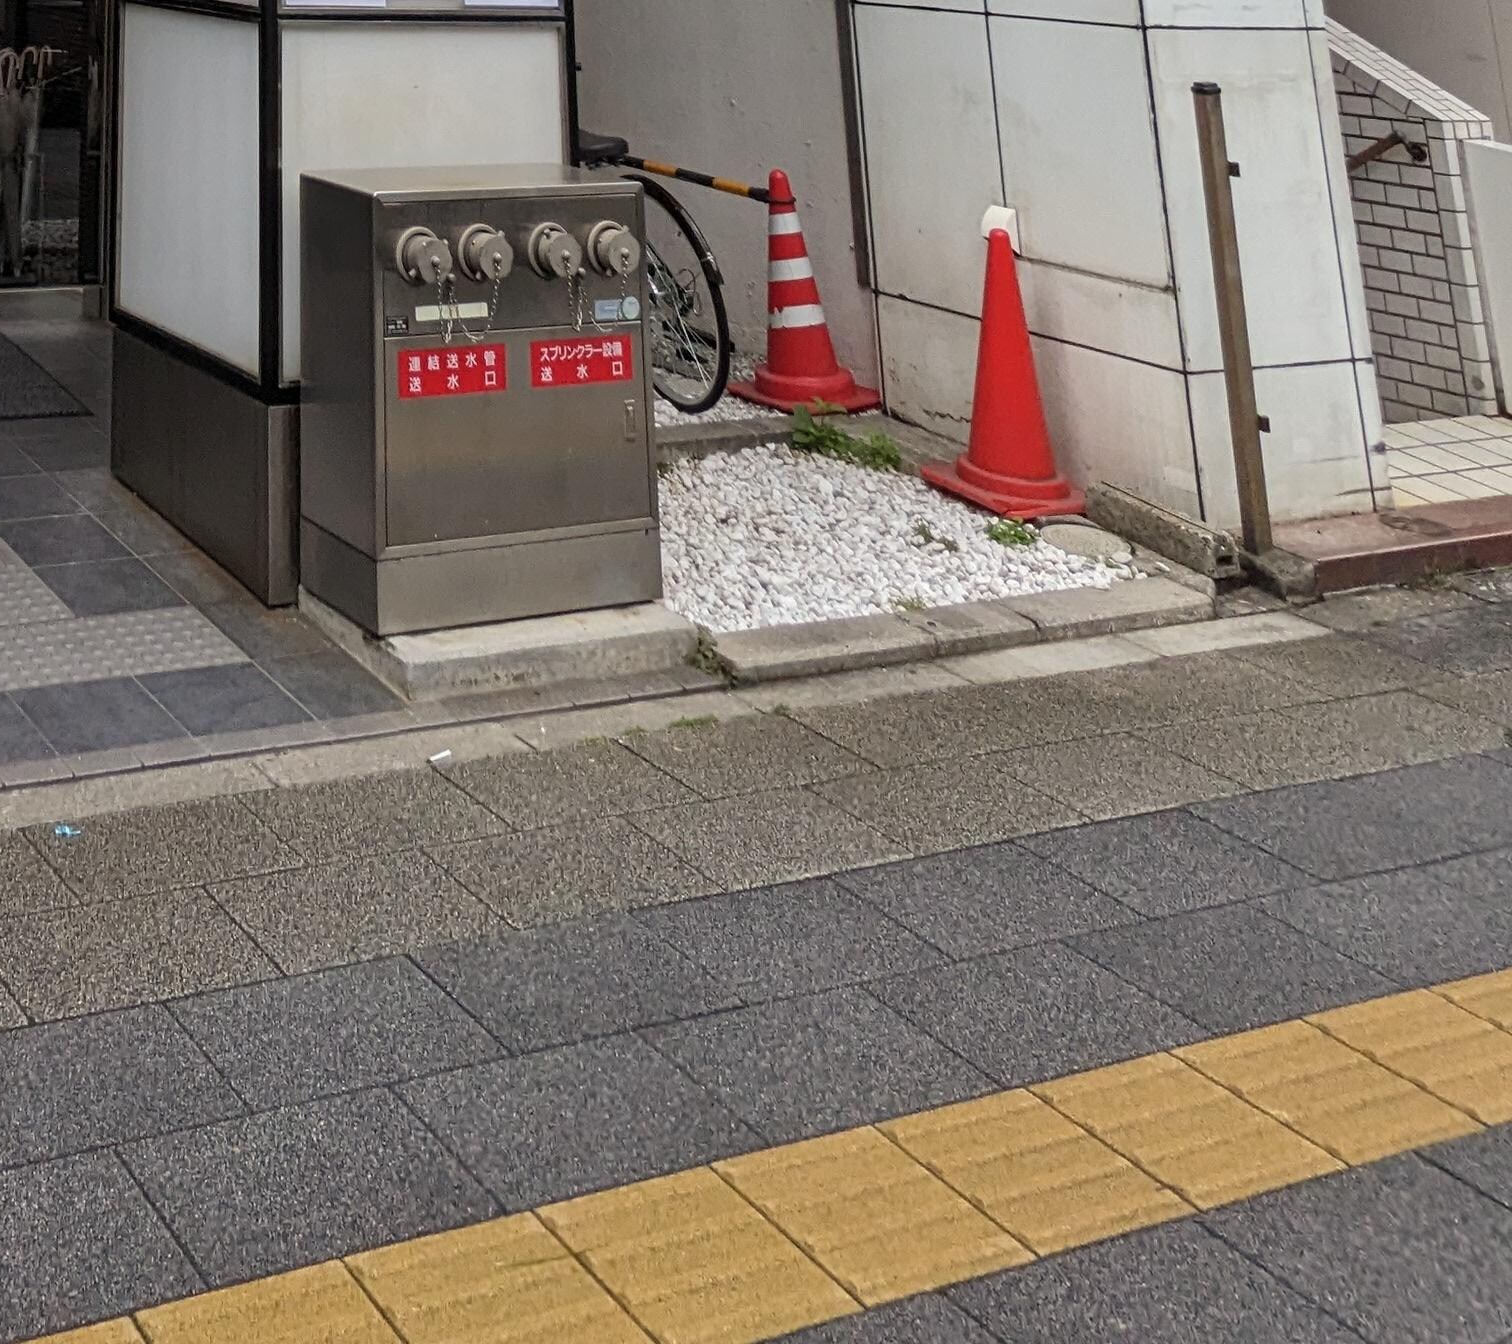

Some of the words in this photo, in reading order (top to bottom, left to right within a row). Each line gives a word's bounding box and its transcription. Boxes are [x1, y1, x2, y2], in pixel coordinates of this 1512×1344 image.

[408, 350, 496, 373] 連結送水管
[540, 341, 623, 361] スプリンクラー設備
[409, 370, 497, 393] 送水口
[541, 361, 623, 382] 送水口
